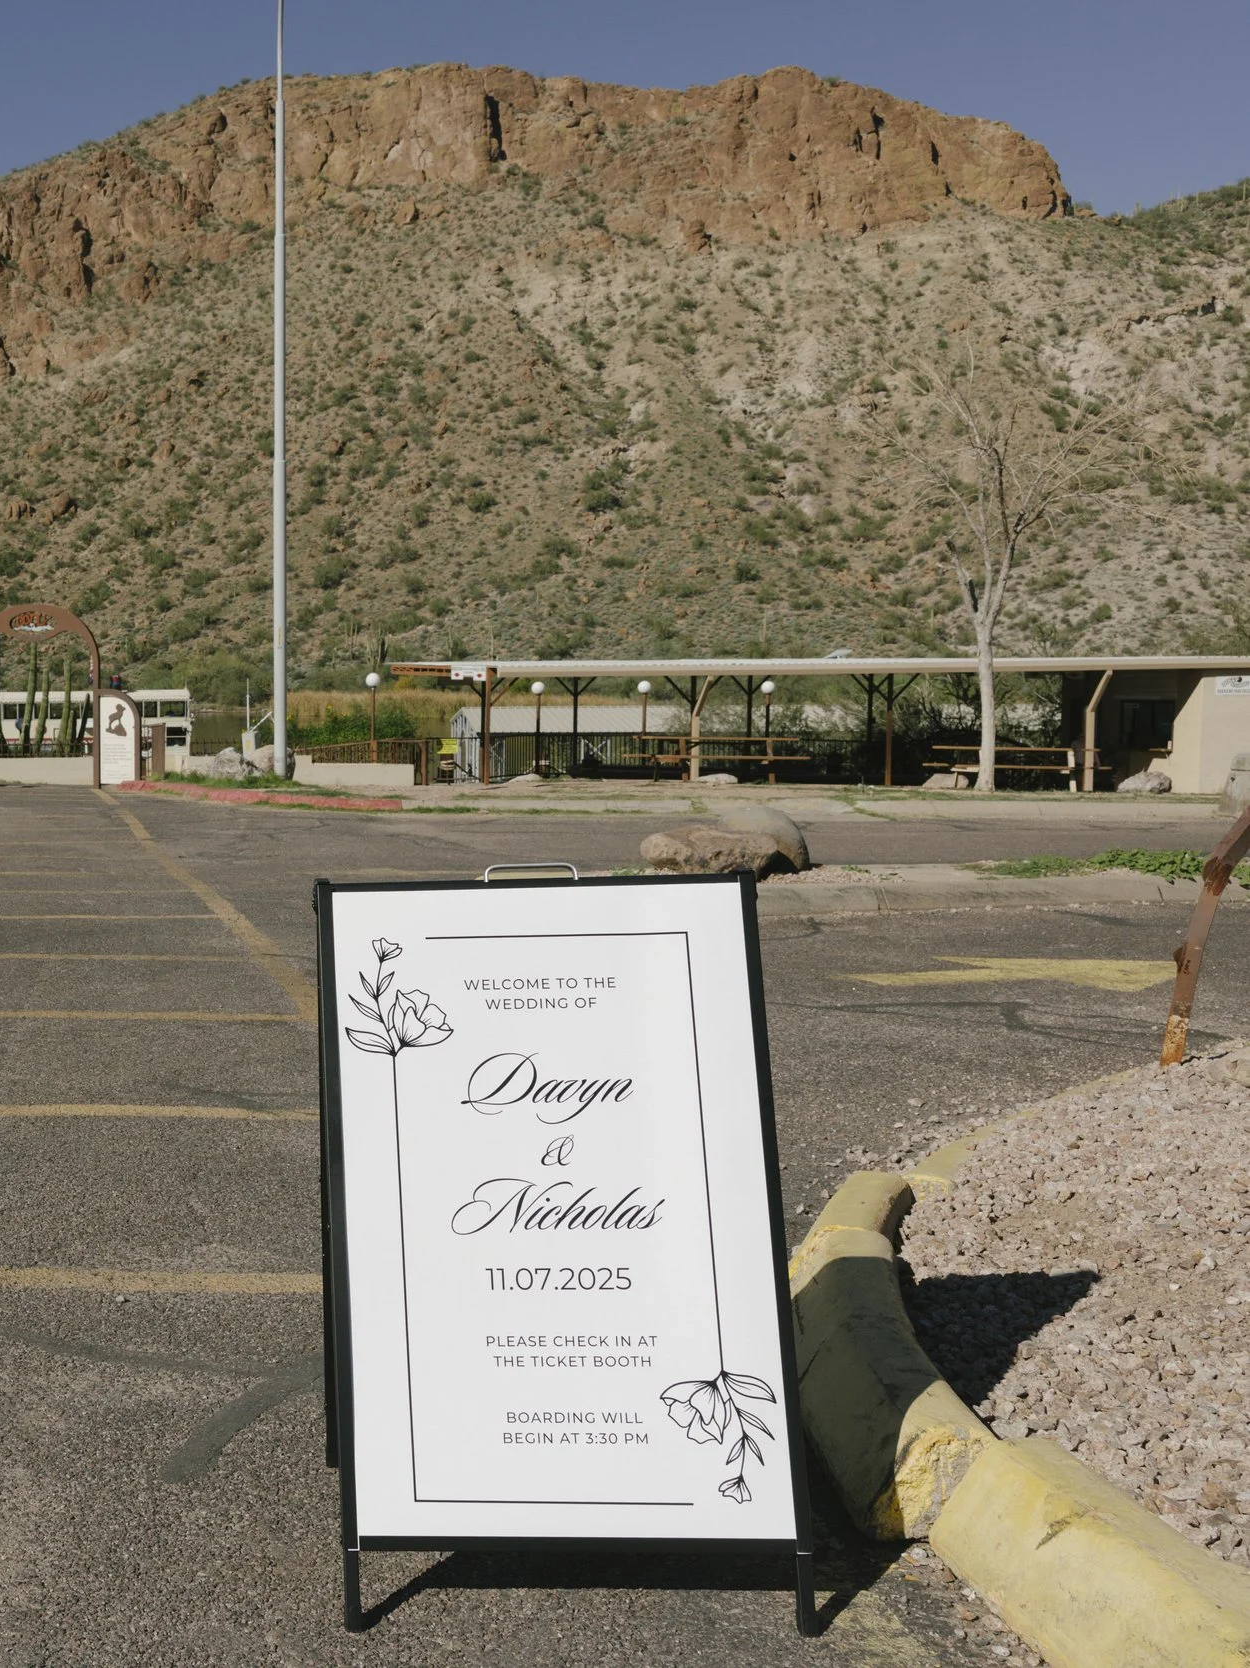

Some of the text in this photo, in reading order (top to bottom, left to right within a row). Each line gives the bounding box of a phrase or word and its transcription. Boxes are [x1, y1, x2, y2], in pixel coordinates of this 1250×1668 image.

[463, 976, 616, 991] WELCOME TO THE
[485, 997, 597, 1010] WEDDING OF
[461, 1053, 634, 1125] Davyn
[540, 1135, 574, 1167] &
[451, 1177, 665, 1235] Nicholas
[485, 1267, 632, 1291] 11.07.2025
[486, 1335, 658, 1347] PLEASE CHECK IN AT
[494, 1355, 651, 1368] THE TICKET BOOTH
[506, 1411, 643, 1424] BOARDING WILL
[503, 1432, 649, 1445] BEGIN AT 3:30 PM
